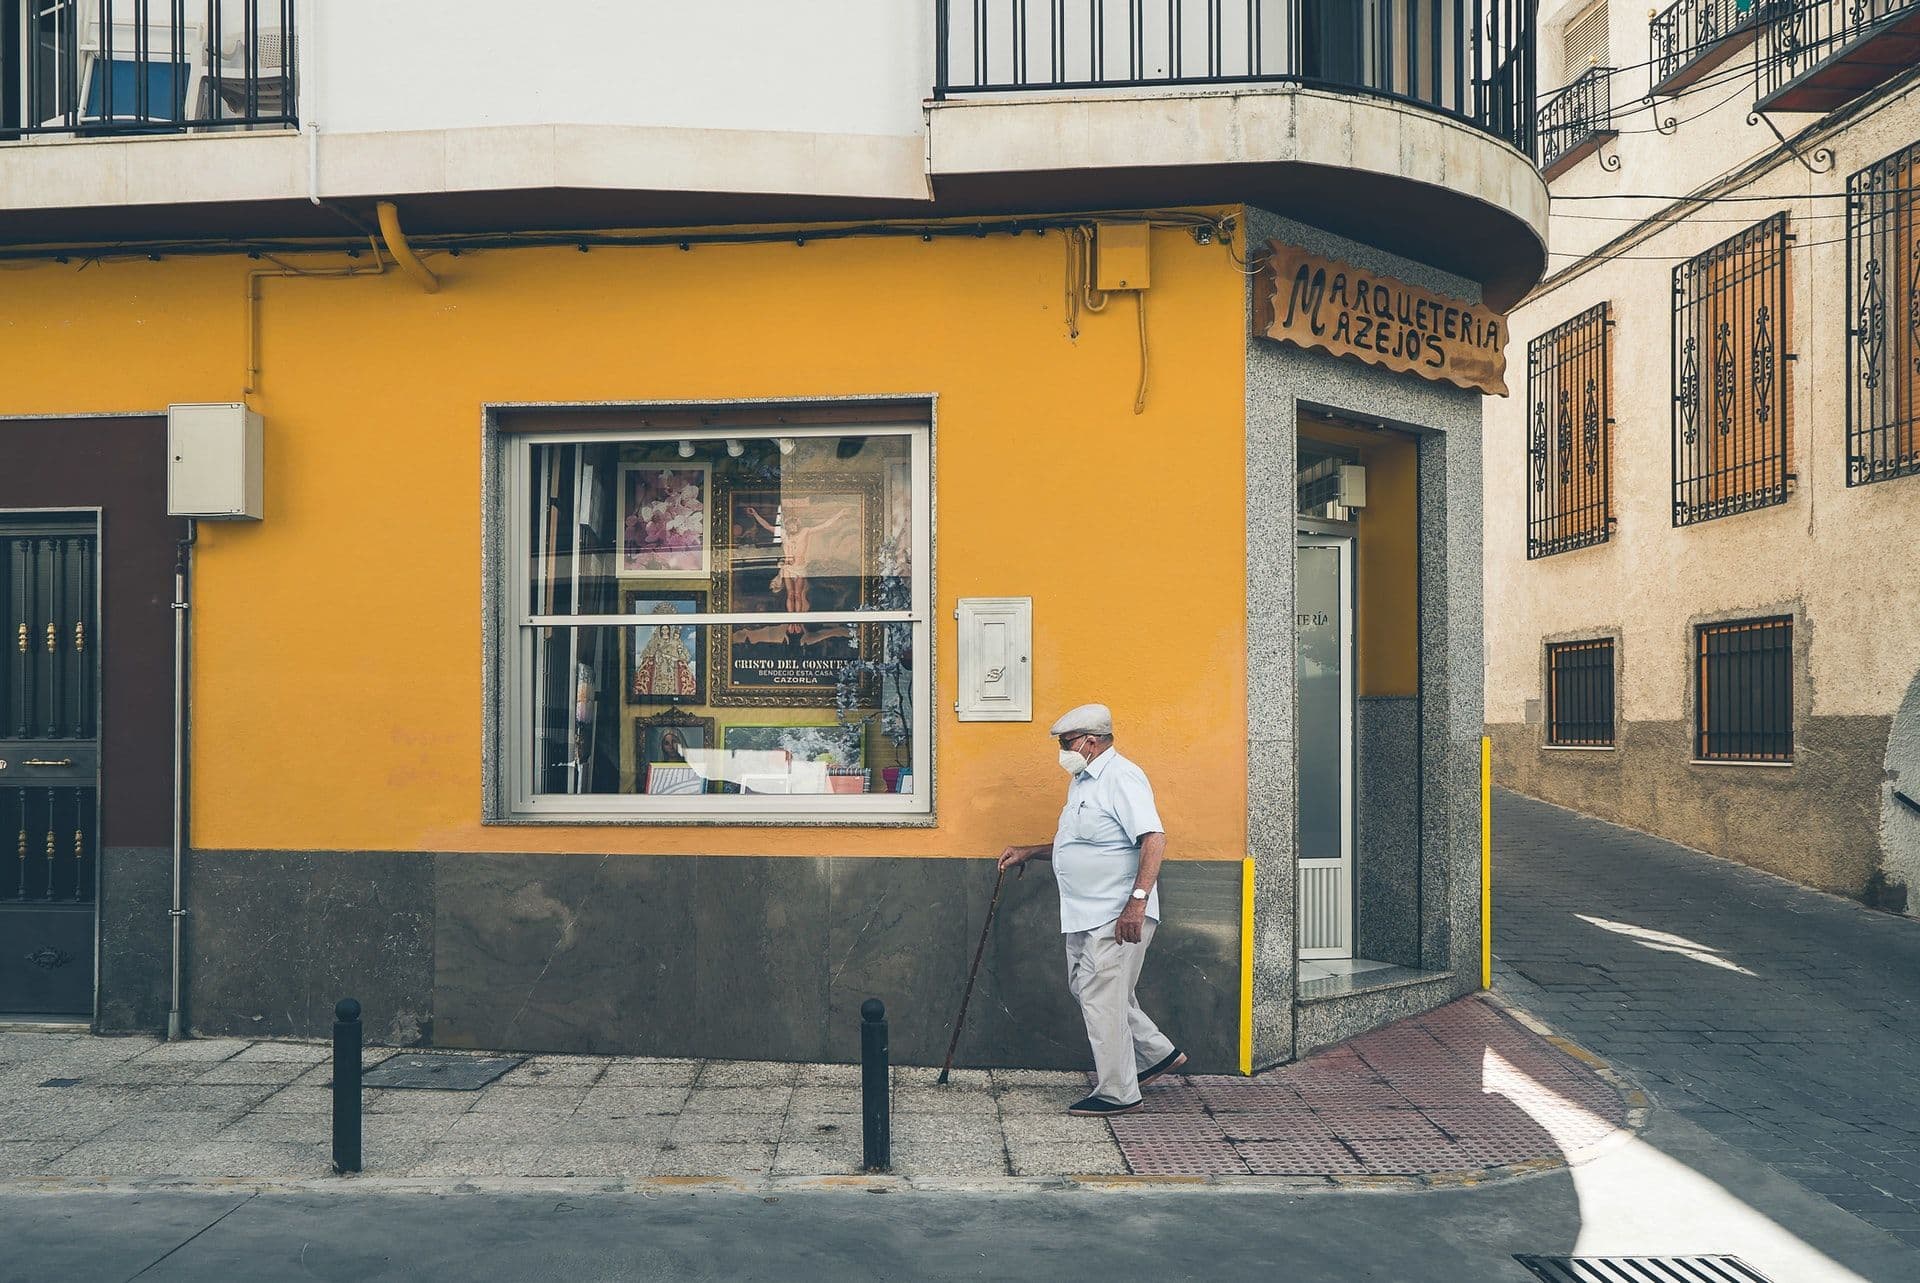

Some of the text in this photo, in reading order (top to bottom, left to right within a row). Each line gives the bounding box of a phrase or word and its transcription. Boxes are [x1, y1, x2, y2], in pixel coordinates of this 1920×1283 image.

[734, 659, 850, 670] CRISTO DEL CONSUE
[796, 669, 813, 677] ESTA
